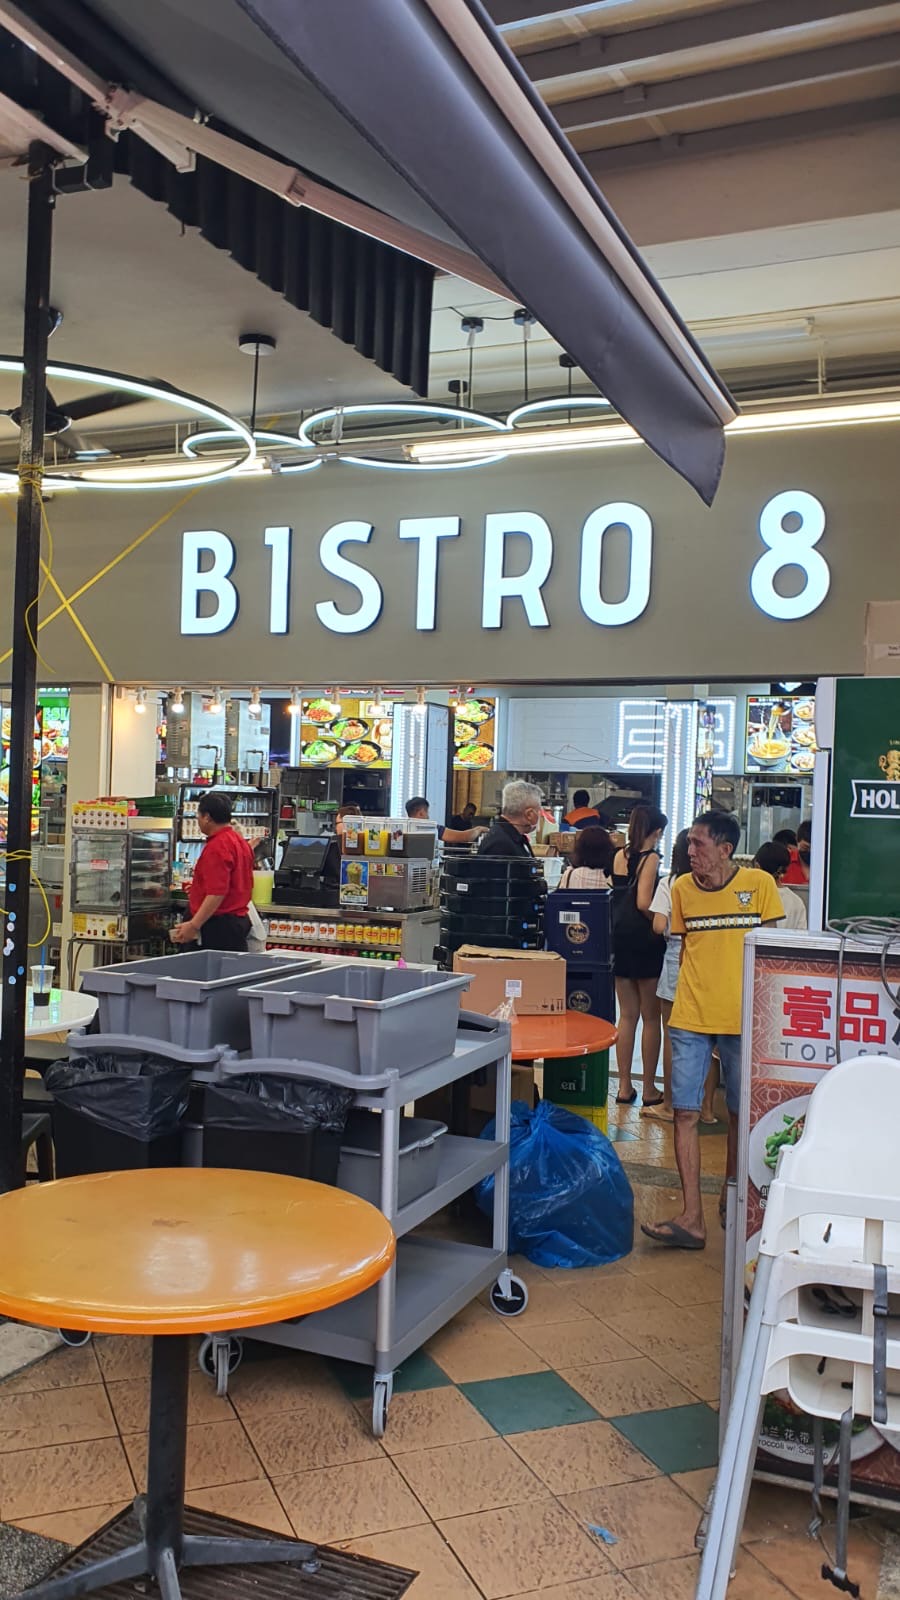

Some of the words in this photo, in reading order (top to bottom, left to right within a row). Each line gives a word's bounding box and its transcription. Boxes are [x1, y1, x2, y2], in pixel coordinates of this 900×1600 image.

[750, 489, 832, 622] 8
[781, 985, 900, 1046] 壹品
[780, 1042, 836, 1063] TOP
[759, 1439, 785, 1450] roccoli
